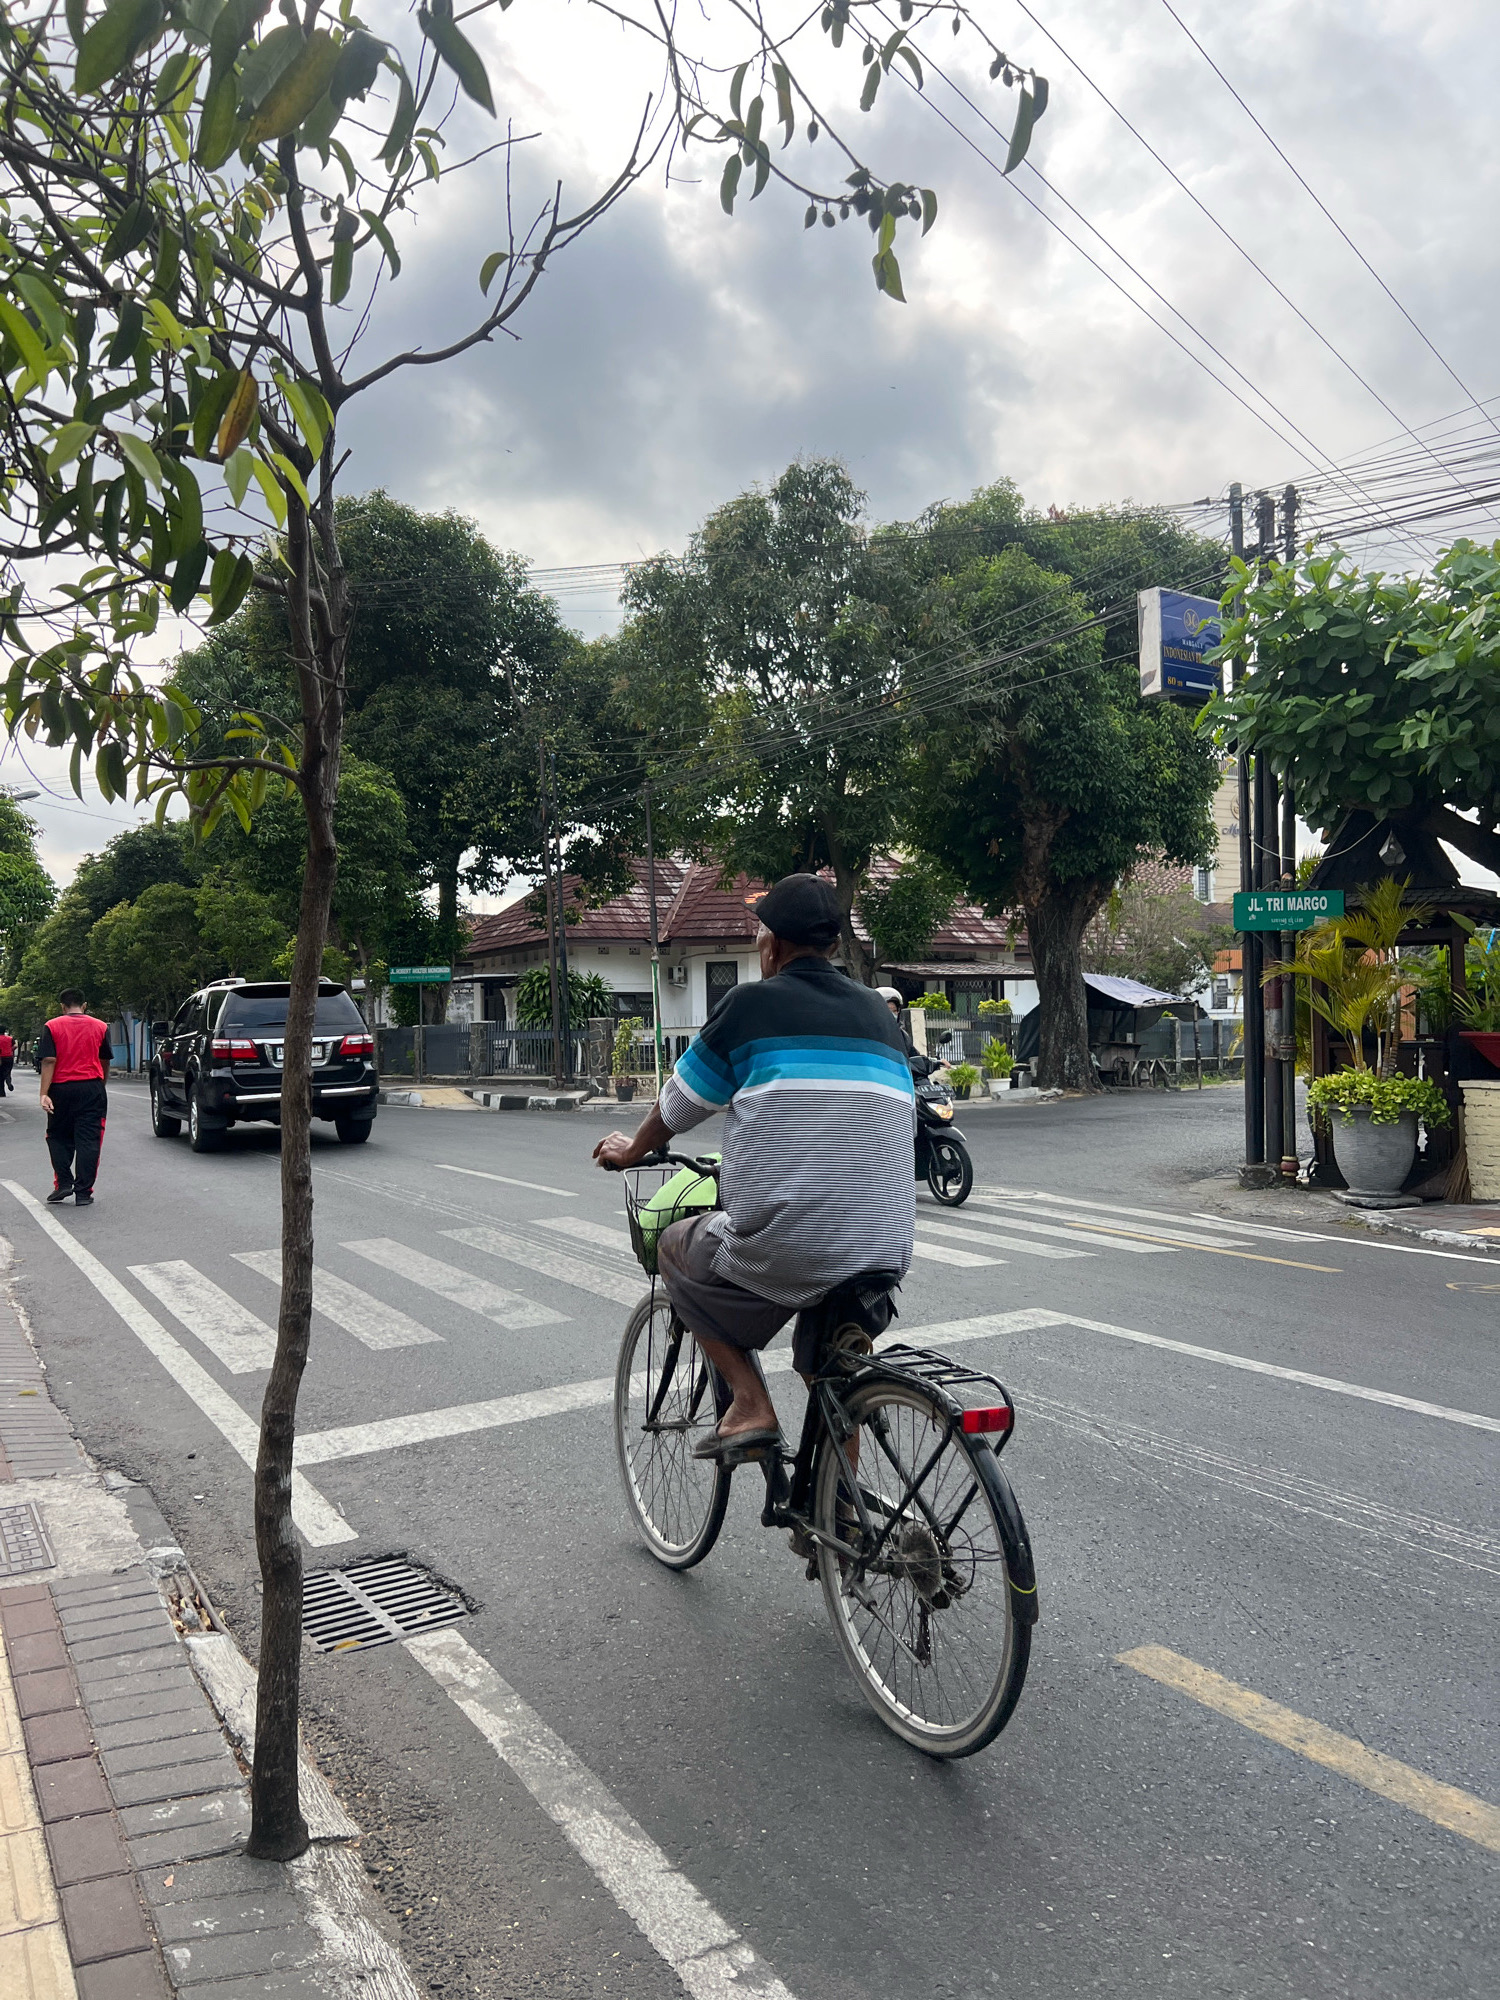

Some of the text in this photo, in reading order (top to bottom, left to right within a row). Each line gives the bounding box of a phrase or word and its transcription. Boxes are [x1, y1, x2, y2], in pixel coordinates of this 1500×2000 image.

[1163, 646, 1195, 662] INDONESIAN
[1248, 896, 1328, 911] JL. TRI MARGO
